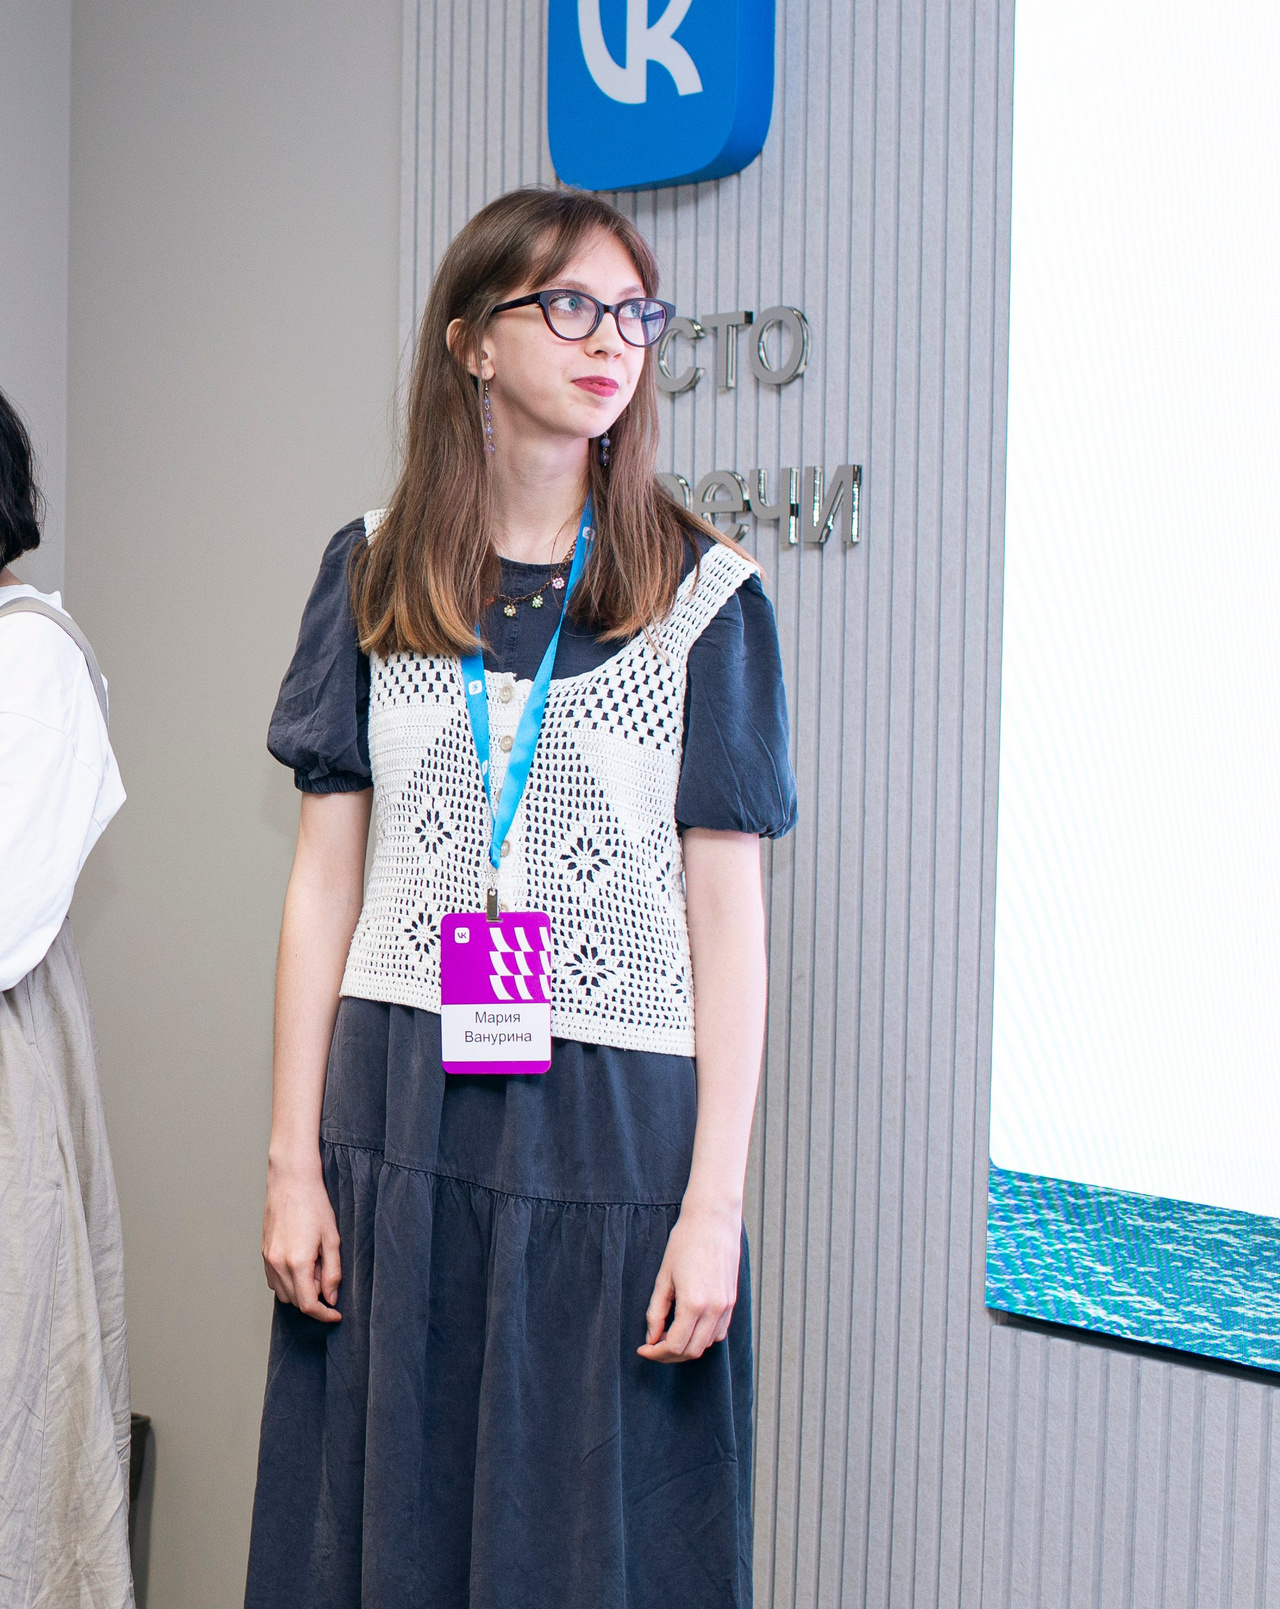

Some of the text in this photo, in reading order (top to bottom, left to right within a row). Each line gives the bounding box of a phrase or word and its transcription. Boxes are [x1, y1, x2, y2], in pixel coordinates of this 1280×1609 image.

[654, 305, 811, 393] сто
[475, 1011, 521, 1026] Мария
[464, 1030, 532, 1045] Ванурина
